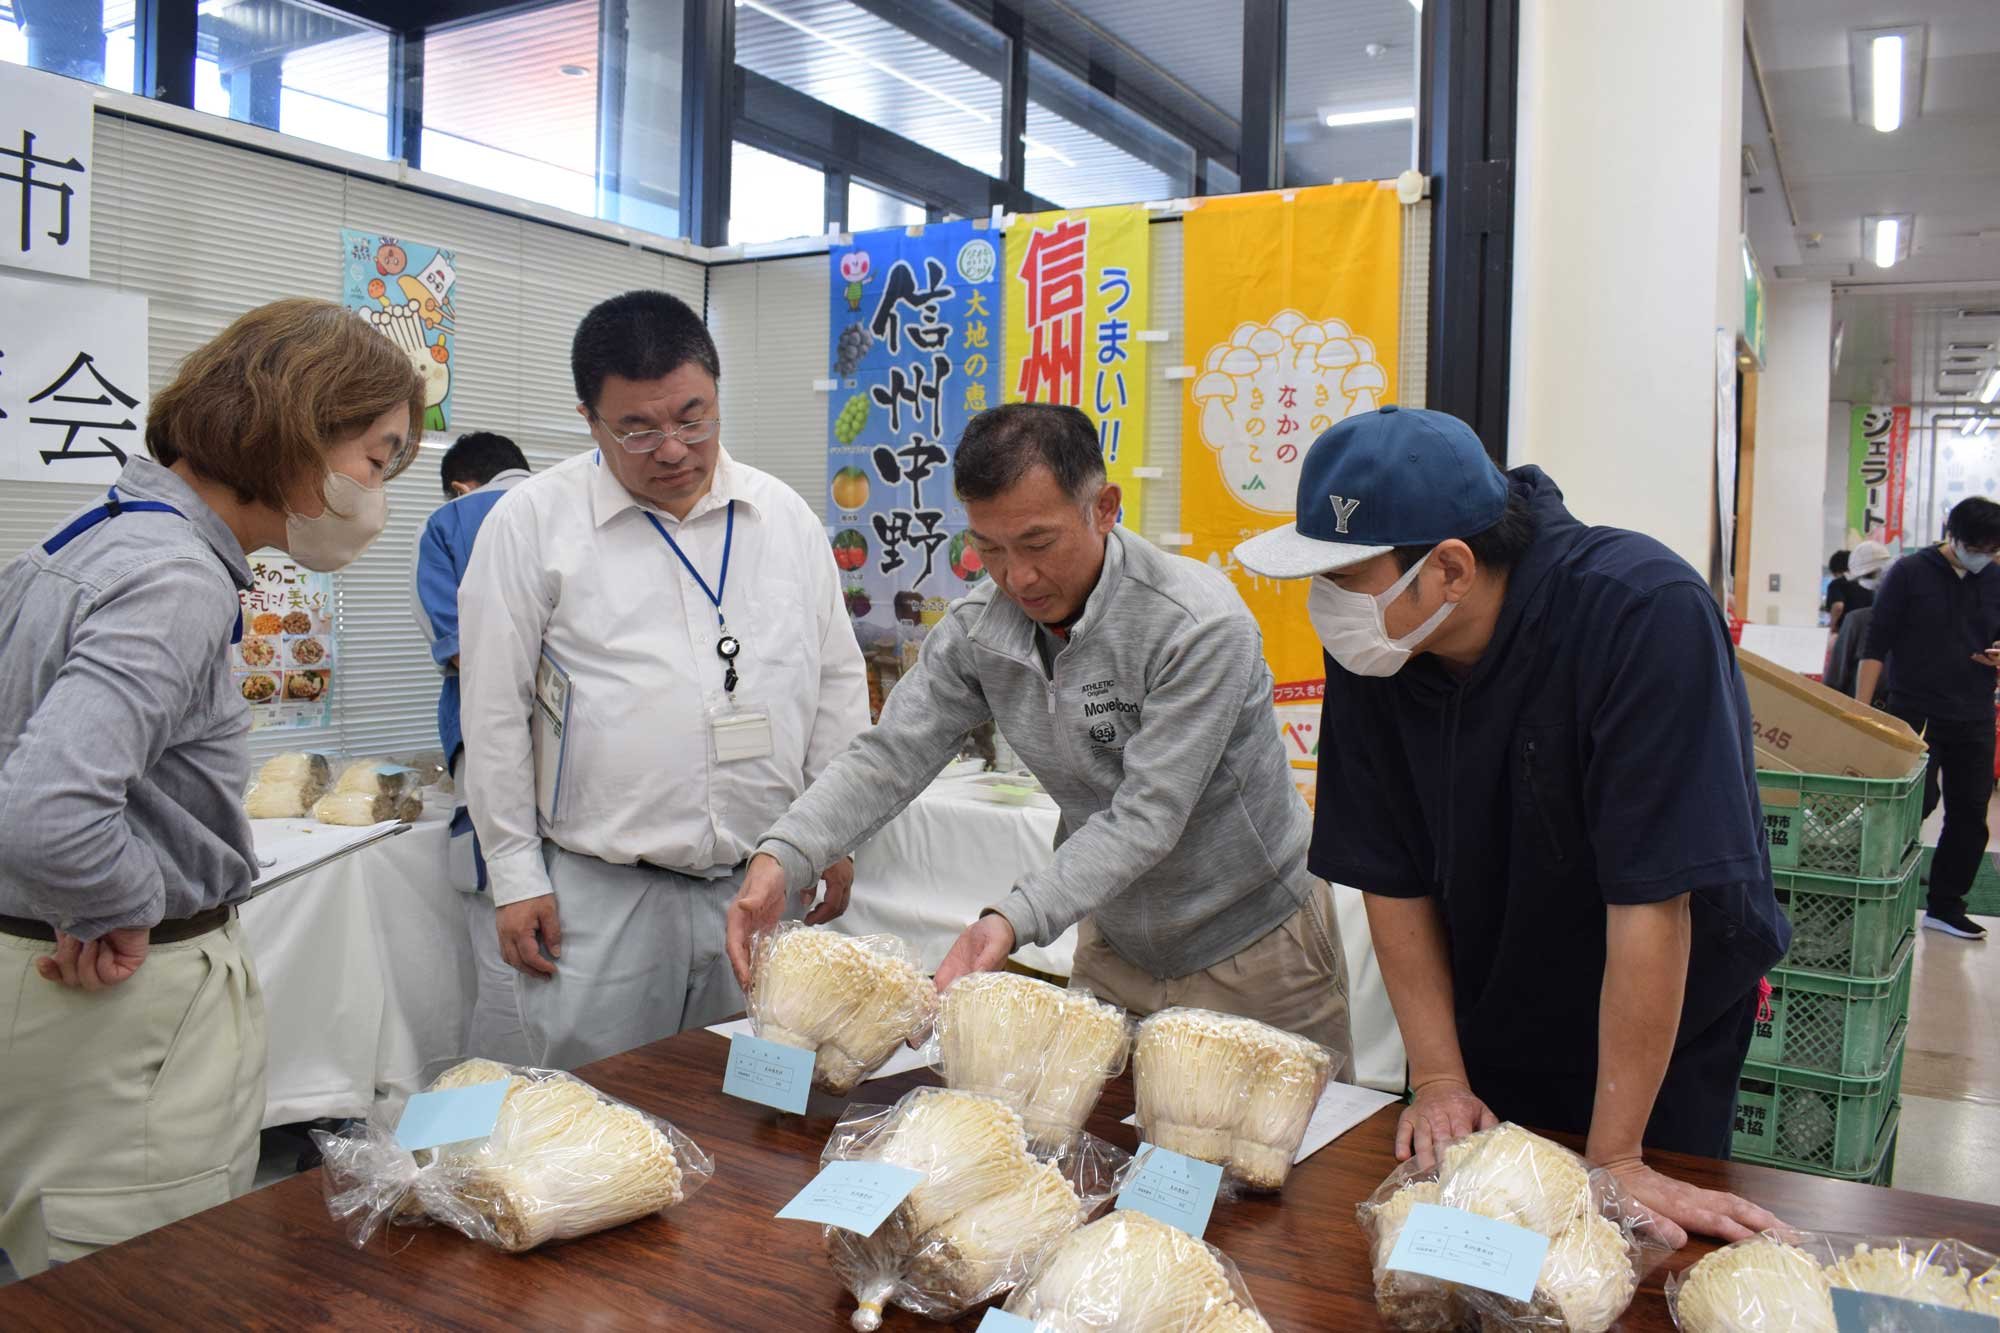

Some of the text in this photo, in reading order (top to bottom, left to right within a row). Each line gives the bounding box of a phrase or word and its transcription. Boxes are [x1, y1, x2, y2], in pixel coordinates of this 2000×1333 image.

[963, 288, 990, 420] 大地の恵
[871, 258, 954, 590] 信州中野
[1246, 387, 1265, 463] きのこ
[1277, 384, 1300, 464] なかの
[1861, 411, 1893, 534] ジェラート
[1329, 495, 1360, 534] Y
[1082, 680, 1115, 693] ATHLETIC
[1762, 814, 1791, 829] 野市
